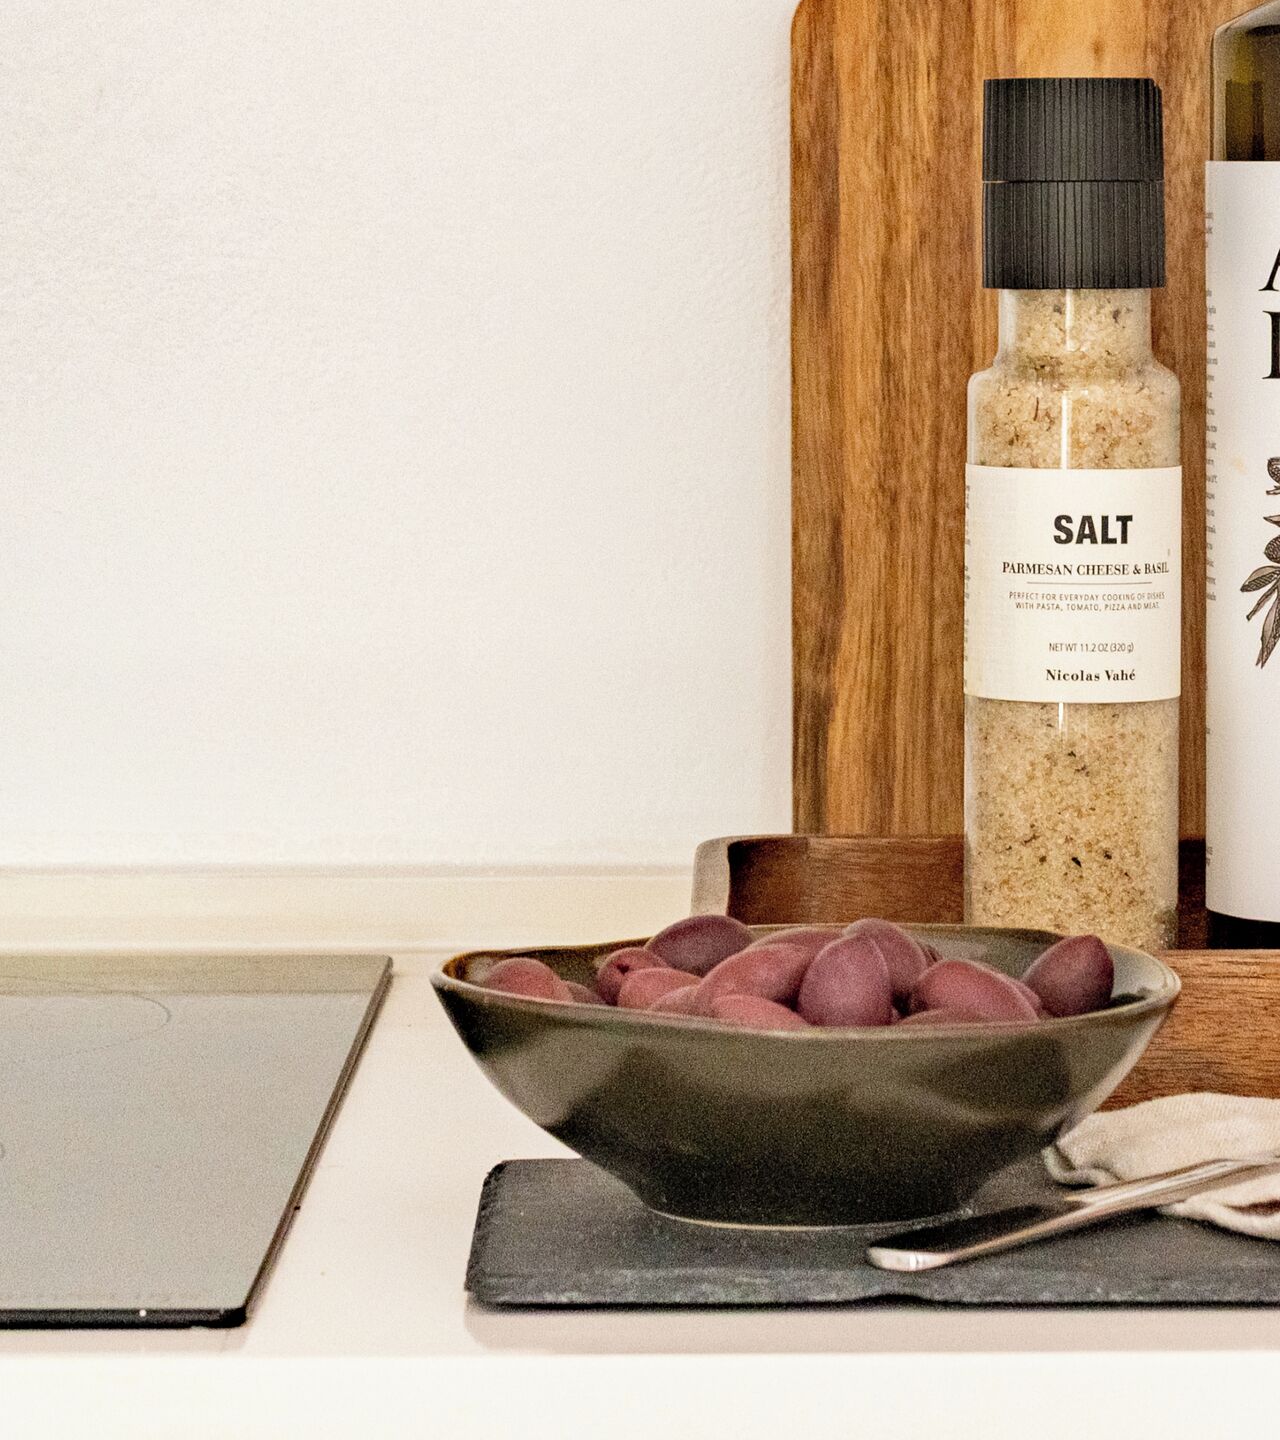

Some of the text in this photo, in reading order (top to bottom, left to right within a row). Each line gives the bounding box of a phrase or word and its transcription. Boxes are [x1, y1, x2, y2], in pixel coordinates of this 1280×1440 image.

[1053, 514, 1133, 545] SALT
[1002, 561, 1169, 576] PARMESAN CHEESE & BASIL
[1008, 591, 1039, 601] PERFECT
[1041, 592, 1057, 601] FOR
[1059, 593, 1099, 601] EVERYDAY
[1102, 592, 1136, 602] COOKING
[1137, 592, 1145, 600] OF
[1015, 602, 1034, 610] WITH
[1036, 602, 1064, 612] PASTA,
[1066, 603, 1102, 612] TOMATO,
[1104, 603, 1126, 611] PIZZA
[1127, 602, 1142, 610] AND
[1049, 641, 1135, 654] NET WT 11.2 OZ (320 g)
[1046, 668, 1136, 681] Nicolas Vahé
